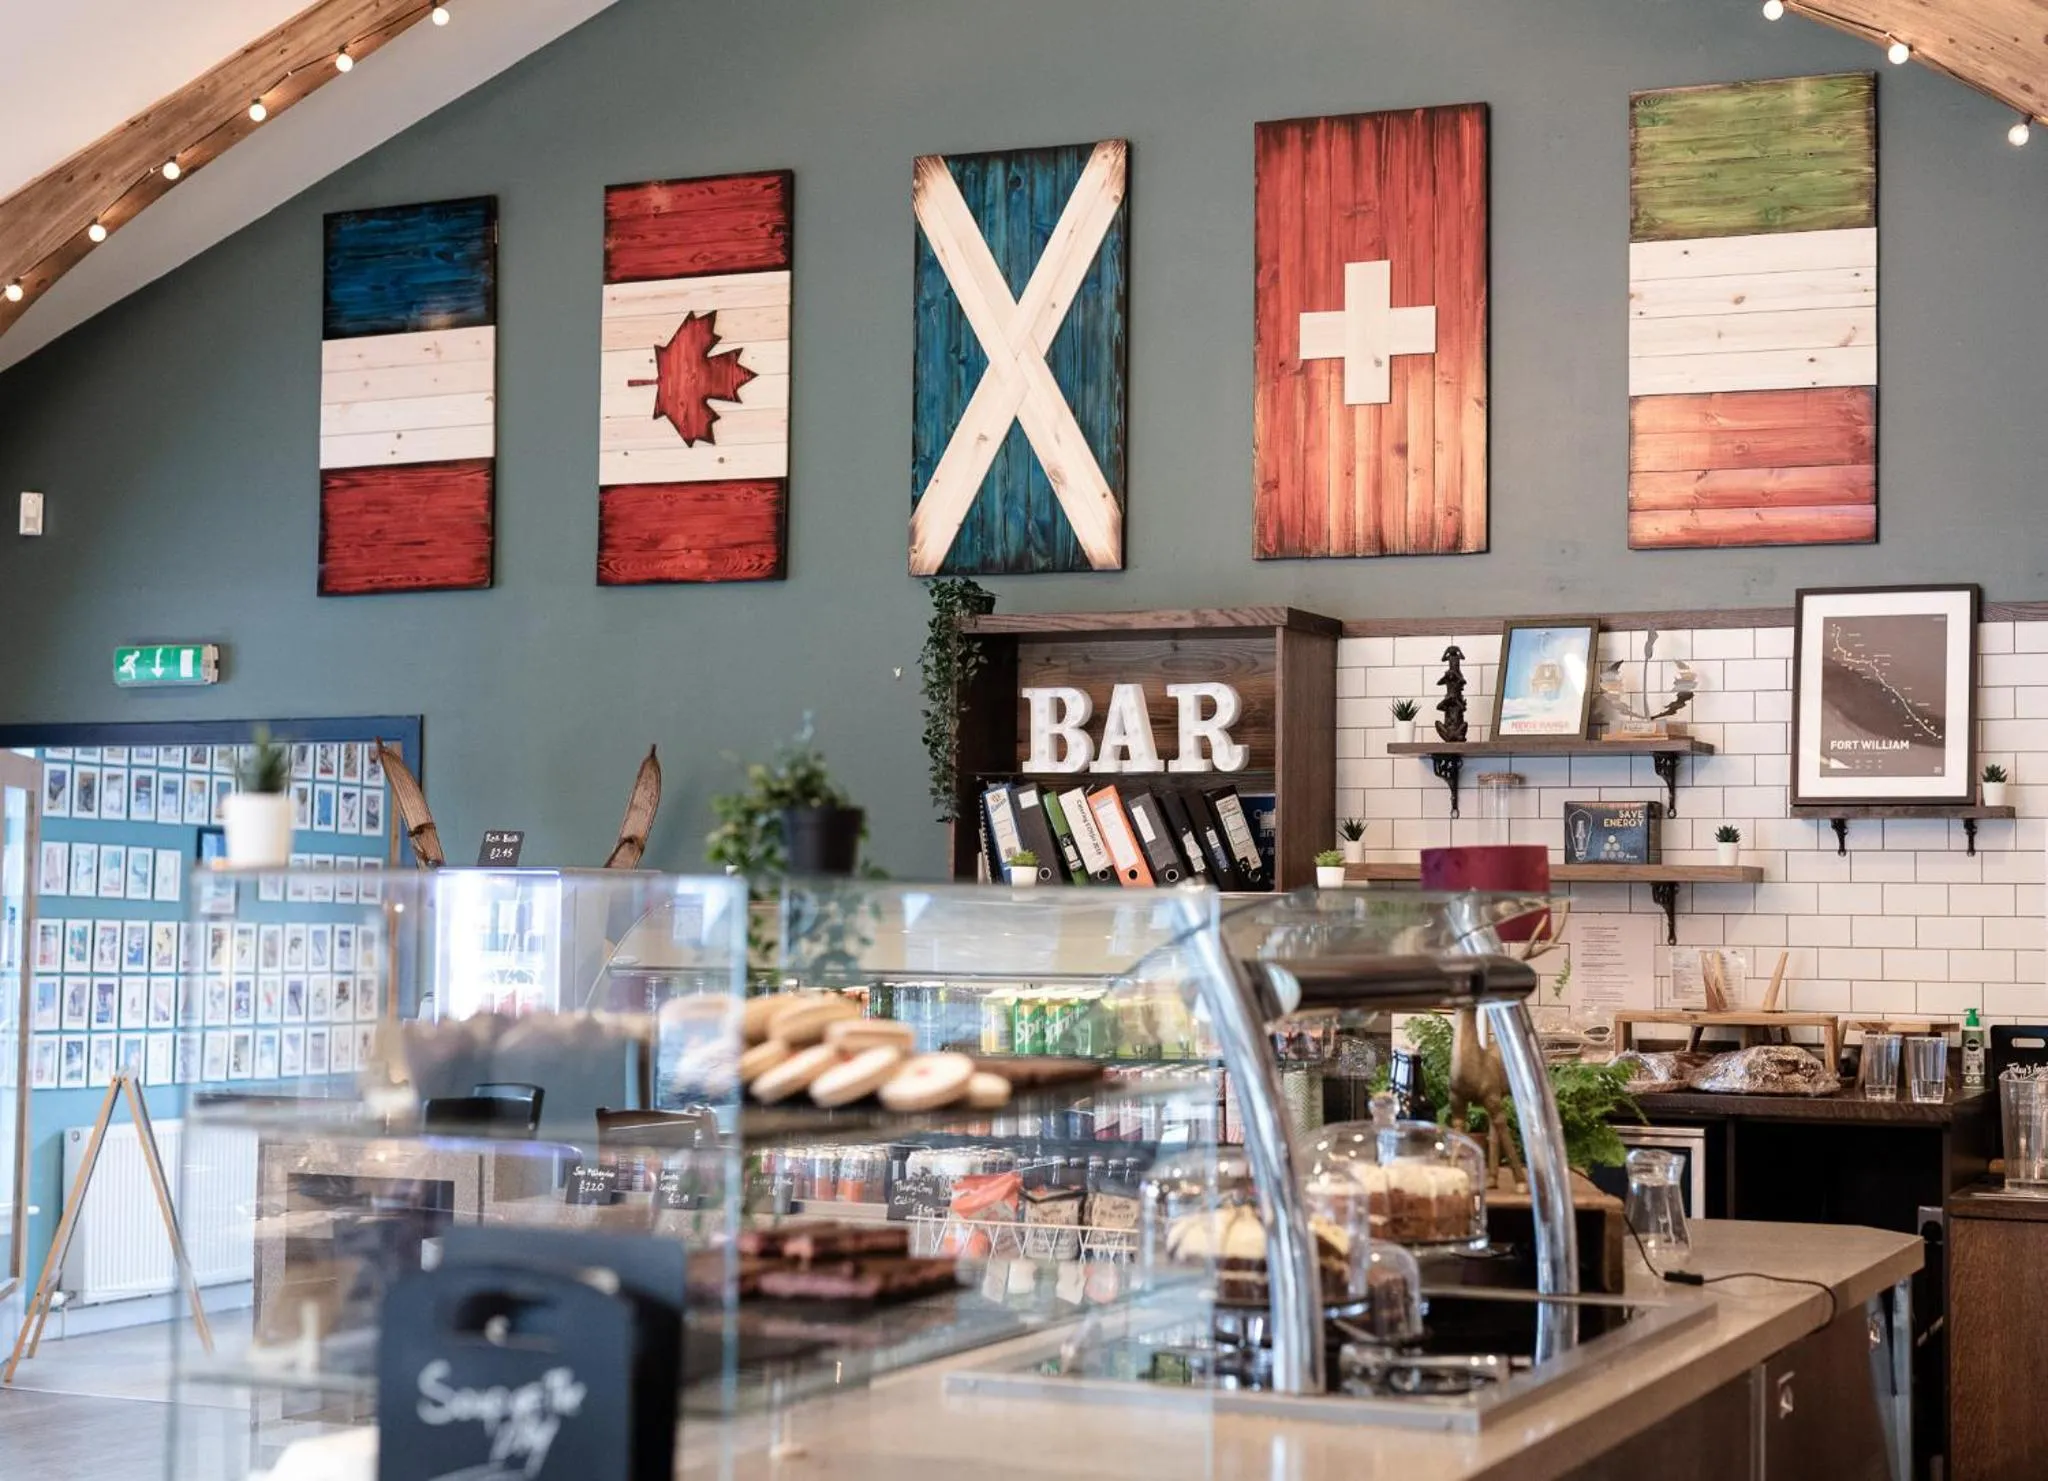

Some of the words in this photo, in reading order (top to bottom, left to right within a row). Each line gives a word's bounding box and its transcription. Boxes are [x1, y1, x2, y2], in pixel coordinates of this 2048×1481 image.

[1021, 682, 1249, 774] BAR
[1830, 740, 1859, 750] FORT
[1861, 739, 1910, 750] WILLIAM
[1618, 810, 1645, 819] SAVE
[1603, 818, 1645, 828] ENERGY
